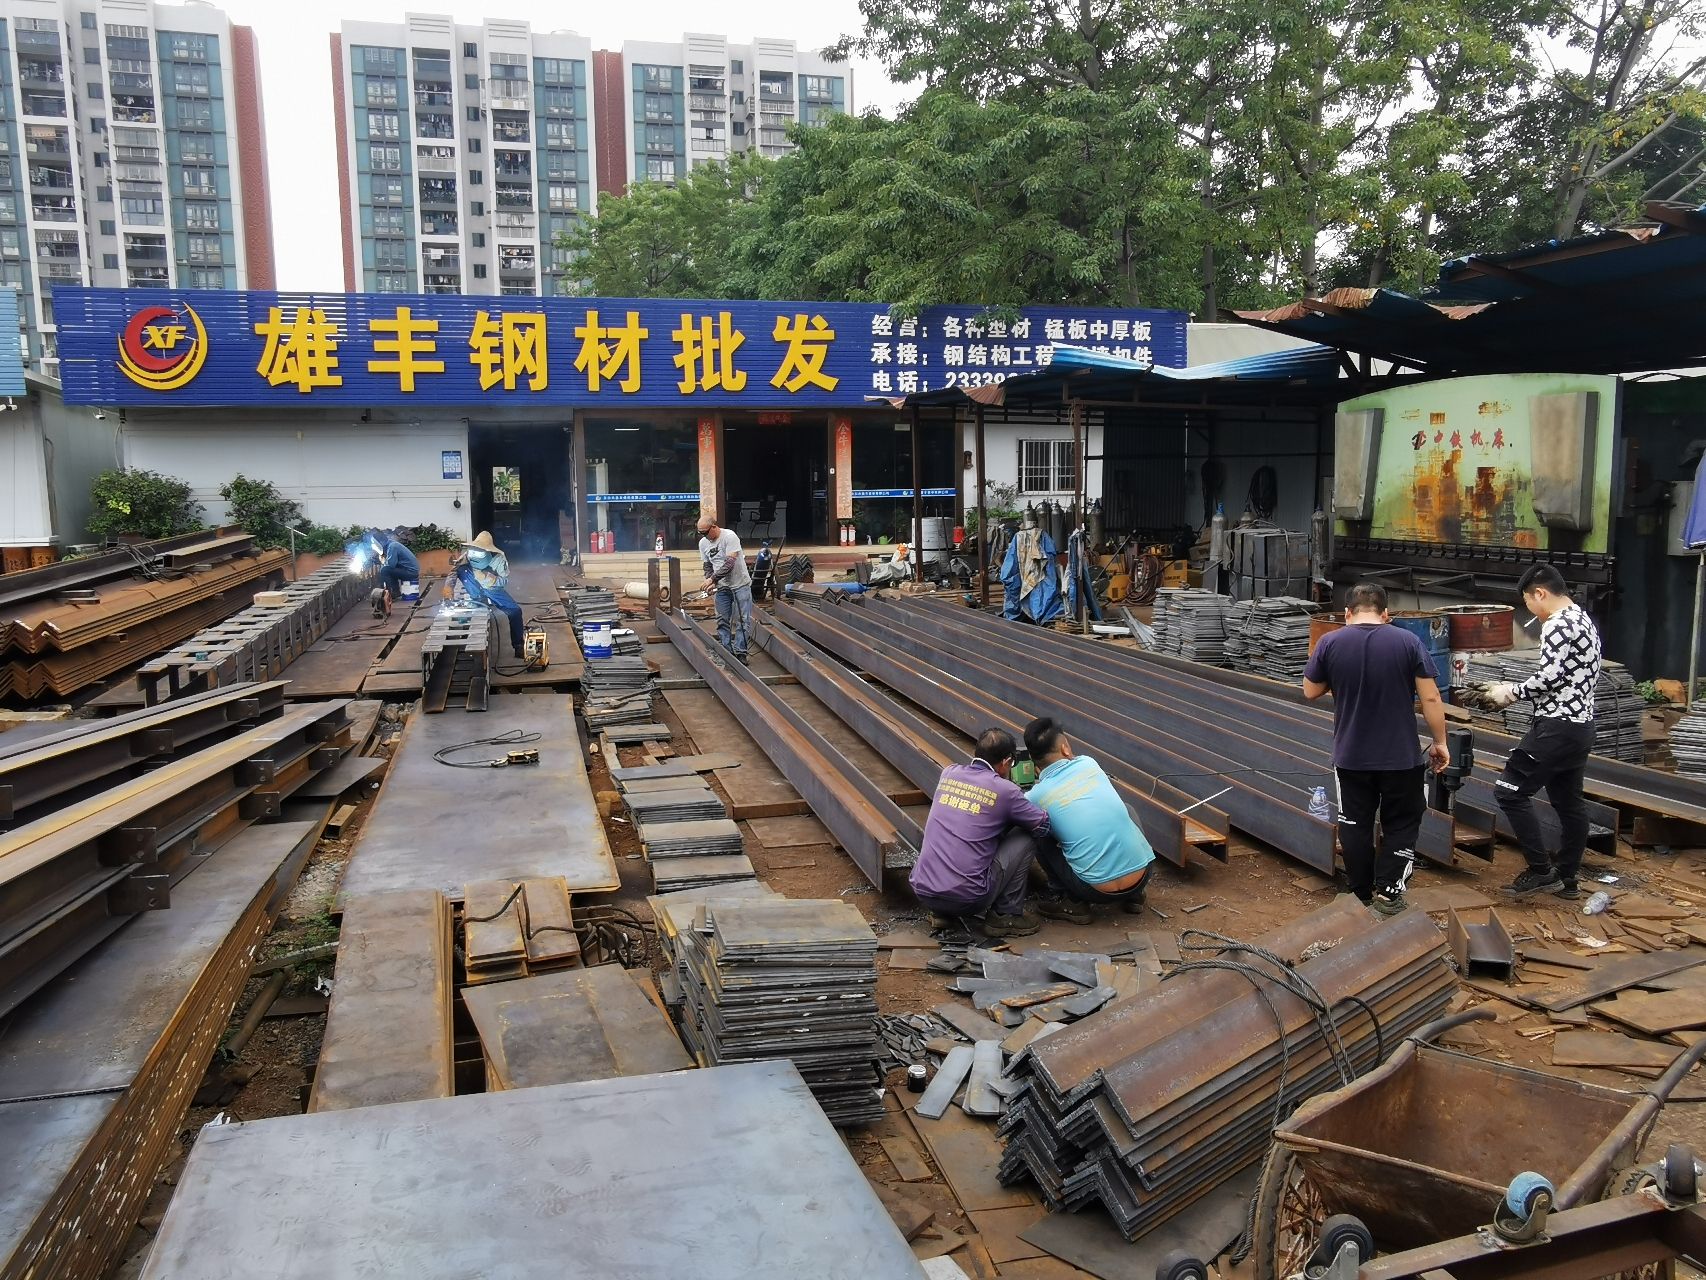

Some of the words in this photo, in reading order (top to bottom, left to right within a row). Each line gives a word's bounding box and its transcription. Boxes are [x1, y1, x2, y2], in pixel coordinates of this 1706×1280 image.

[143, 326, 186, 349] XF
[943, 316, 1031, 339] 各种型材
[254, 307, 839, 393] 雄丰钢材批发
[871, 342, 928, 366] 承接：
[944, 345, 1054, 366] 钢结构工程
[872, 371, 928, 393] 电话：
